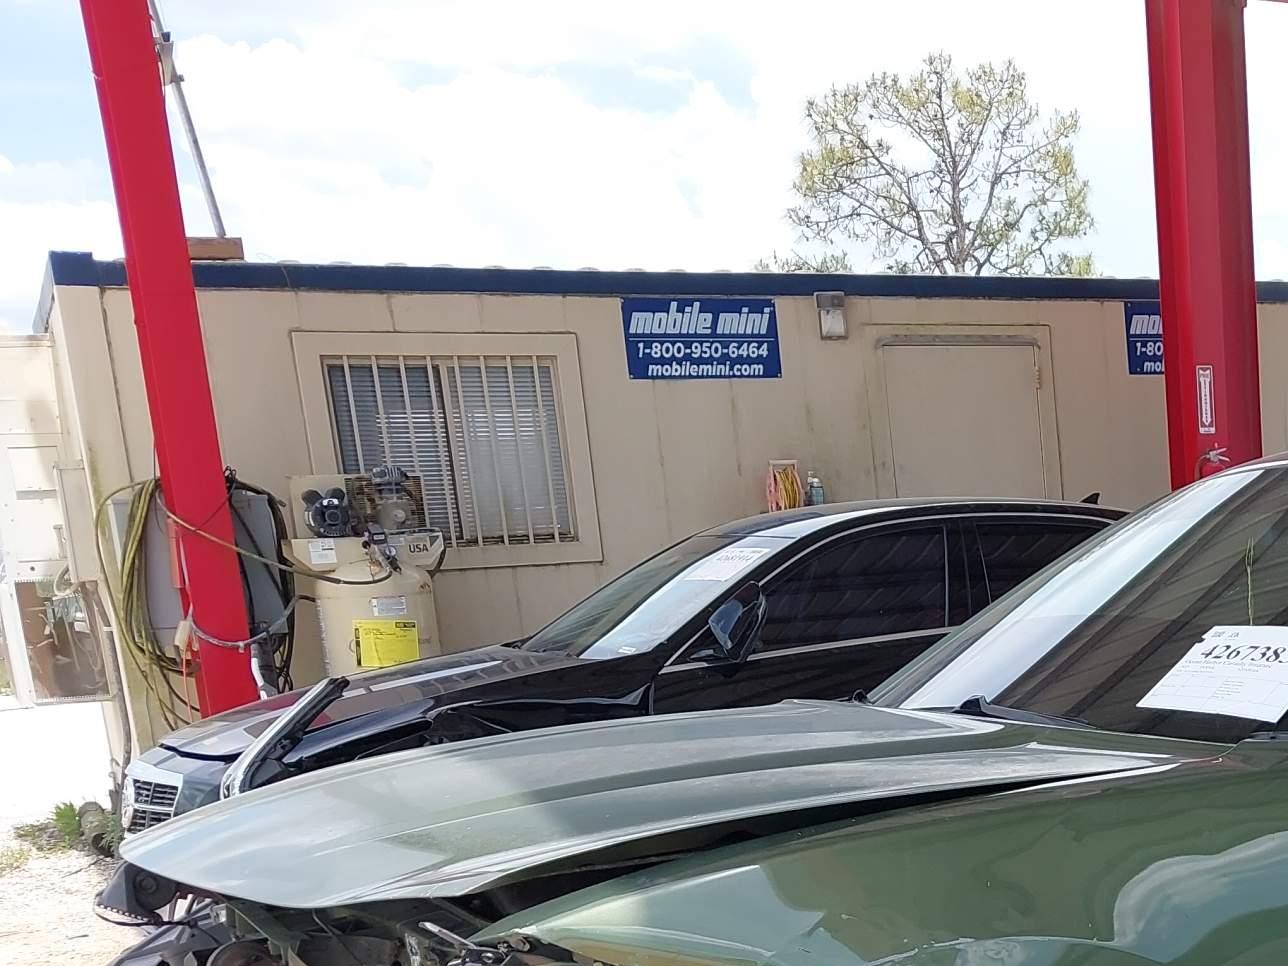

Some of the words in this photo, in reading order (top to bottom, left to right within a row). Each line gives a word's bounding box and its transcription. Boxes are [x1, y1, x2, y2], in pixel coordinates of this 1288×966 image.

[629, 301, 713, 334] mobile
[716, 306, 771, 335] mini
[1130, 314, 1163, 335] mo
[637, 342, 769, 359] 1-800-950-6464
[647, 361, 764, 377] mobilemini.com
[1143, 361, 1164, 373] mo
[408, 543, 429, 554] USA
